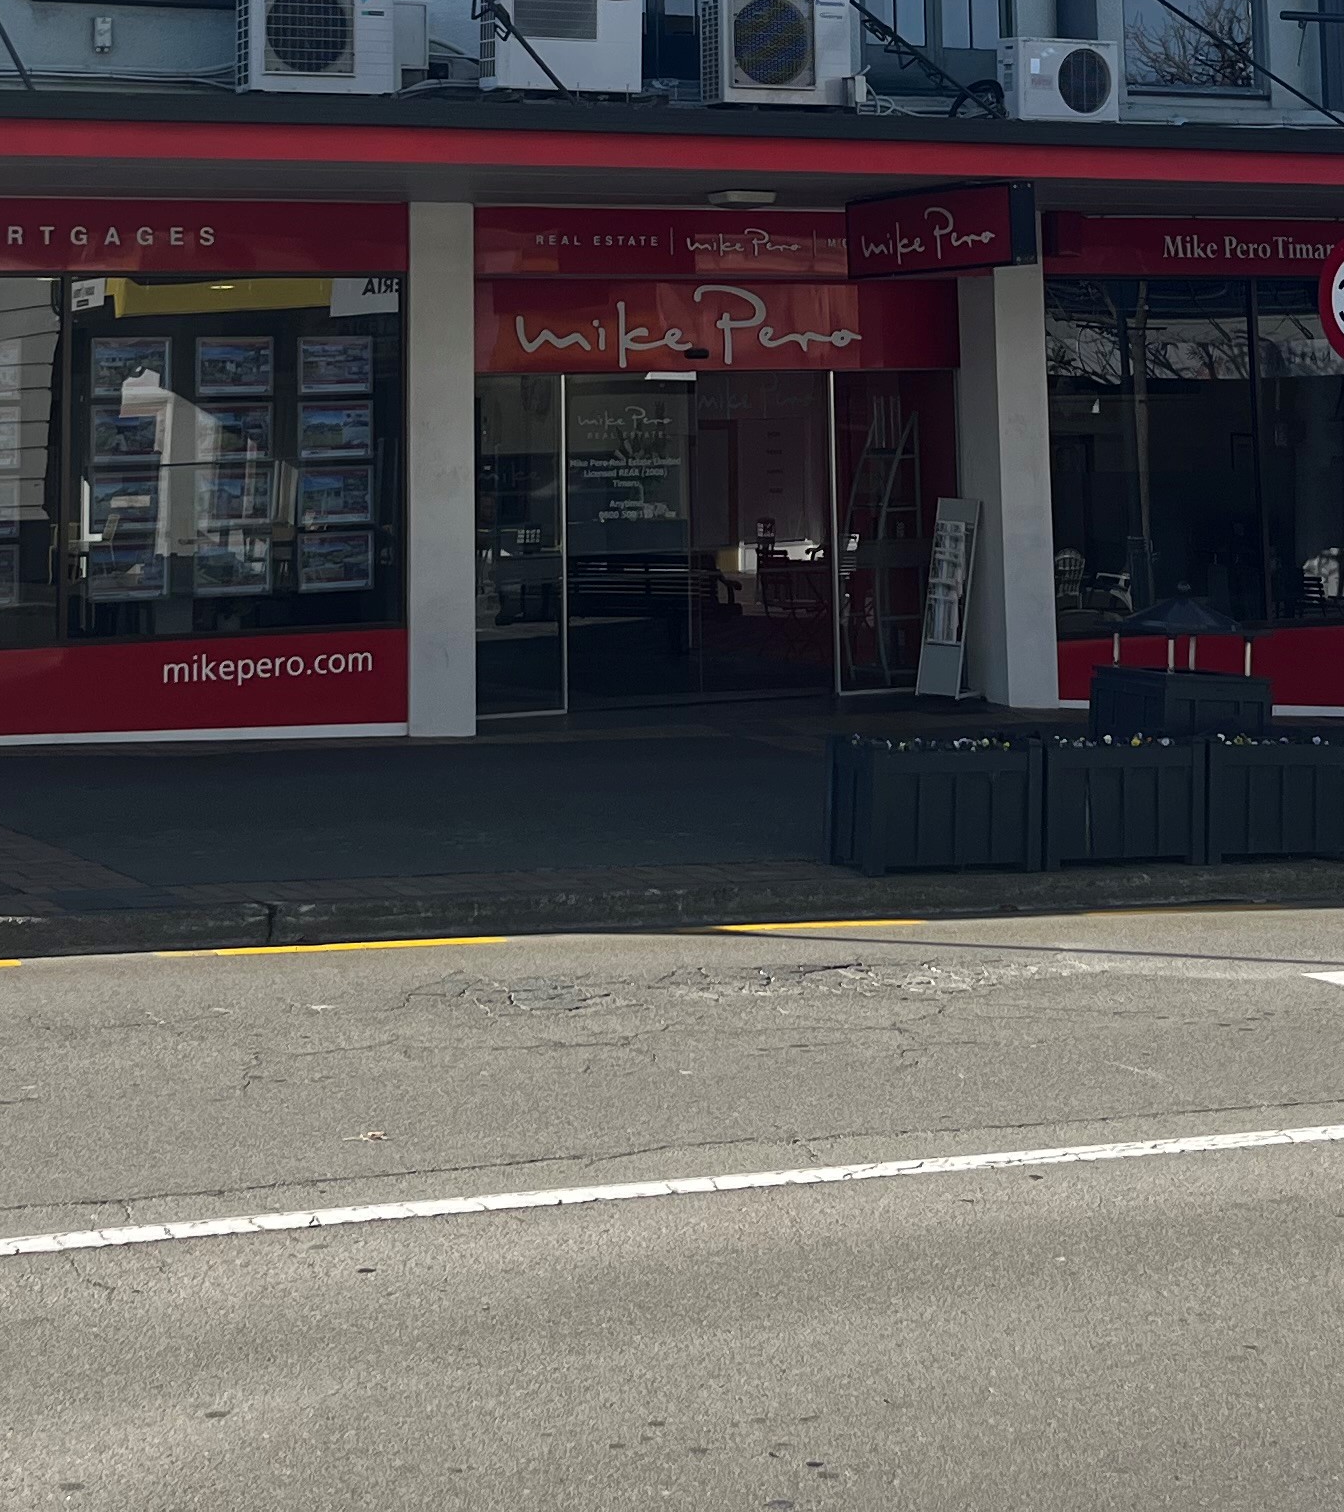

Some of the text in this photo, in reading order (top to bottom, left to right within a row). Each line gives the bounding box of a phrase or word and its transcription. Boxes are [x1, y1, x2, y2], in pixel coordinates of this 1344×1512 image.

[535, 228, 802, 257] REAL ESTATE mike Pero
[861, 206, 996, 265] mike Pero
[1162, 235, 1336, 260] Mike Pero Timar
[516, 285, 863, 369] mike Pero
[586, 430, 664, 440] REAL ESTATE
[162, 651, 373, 687] mikepero.com
